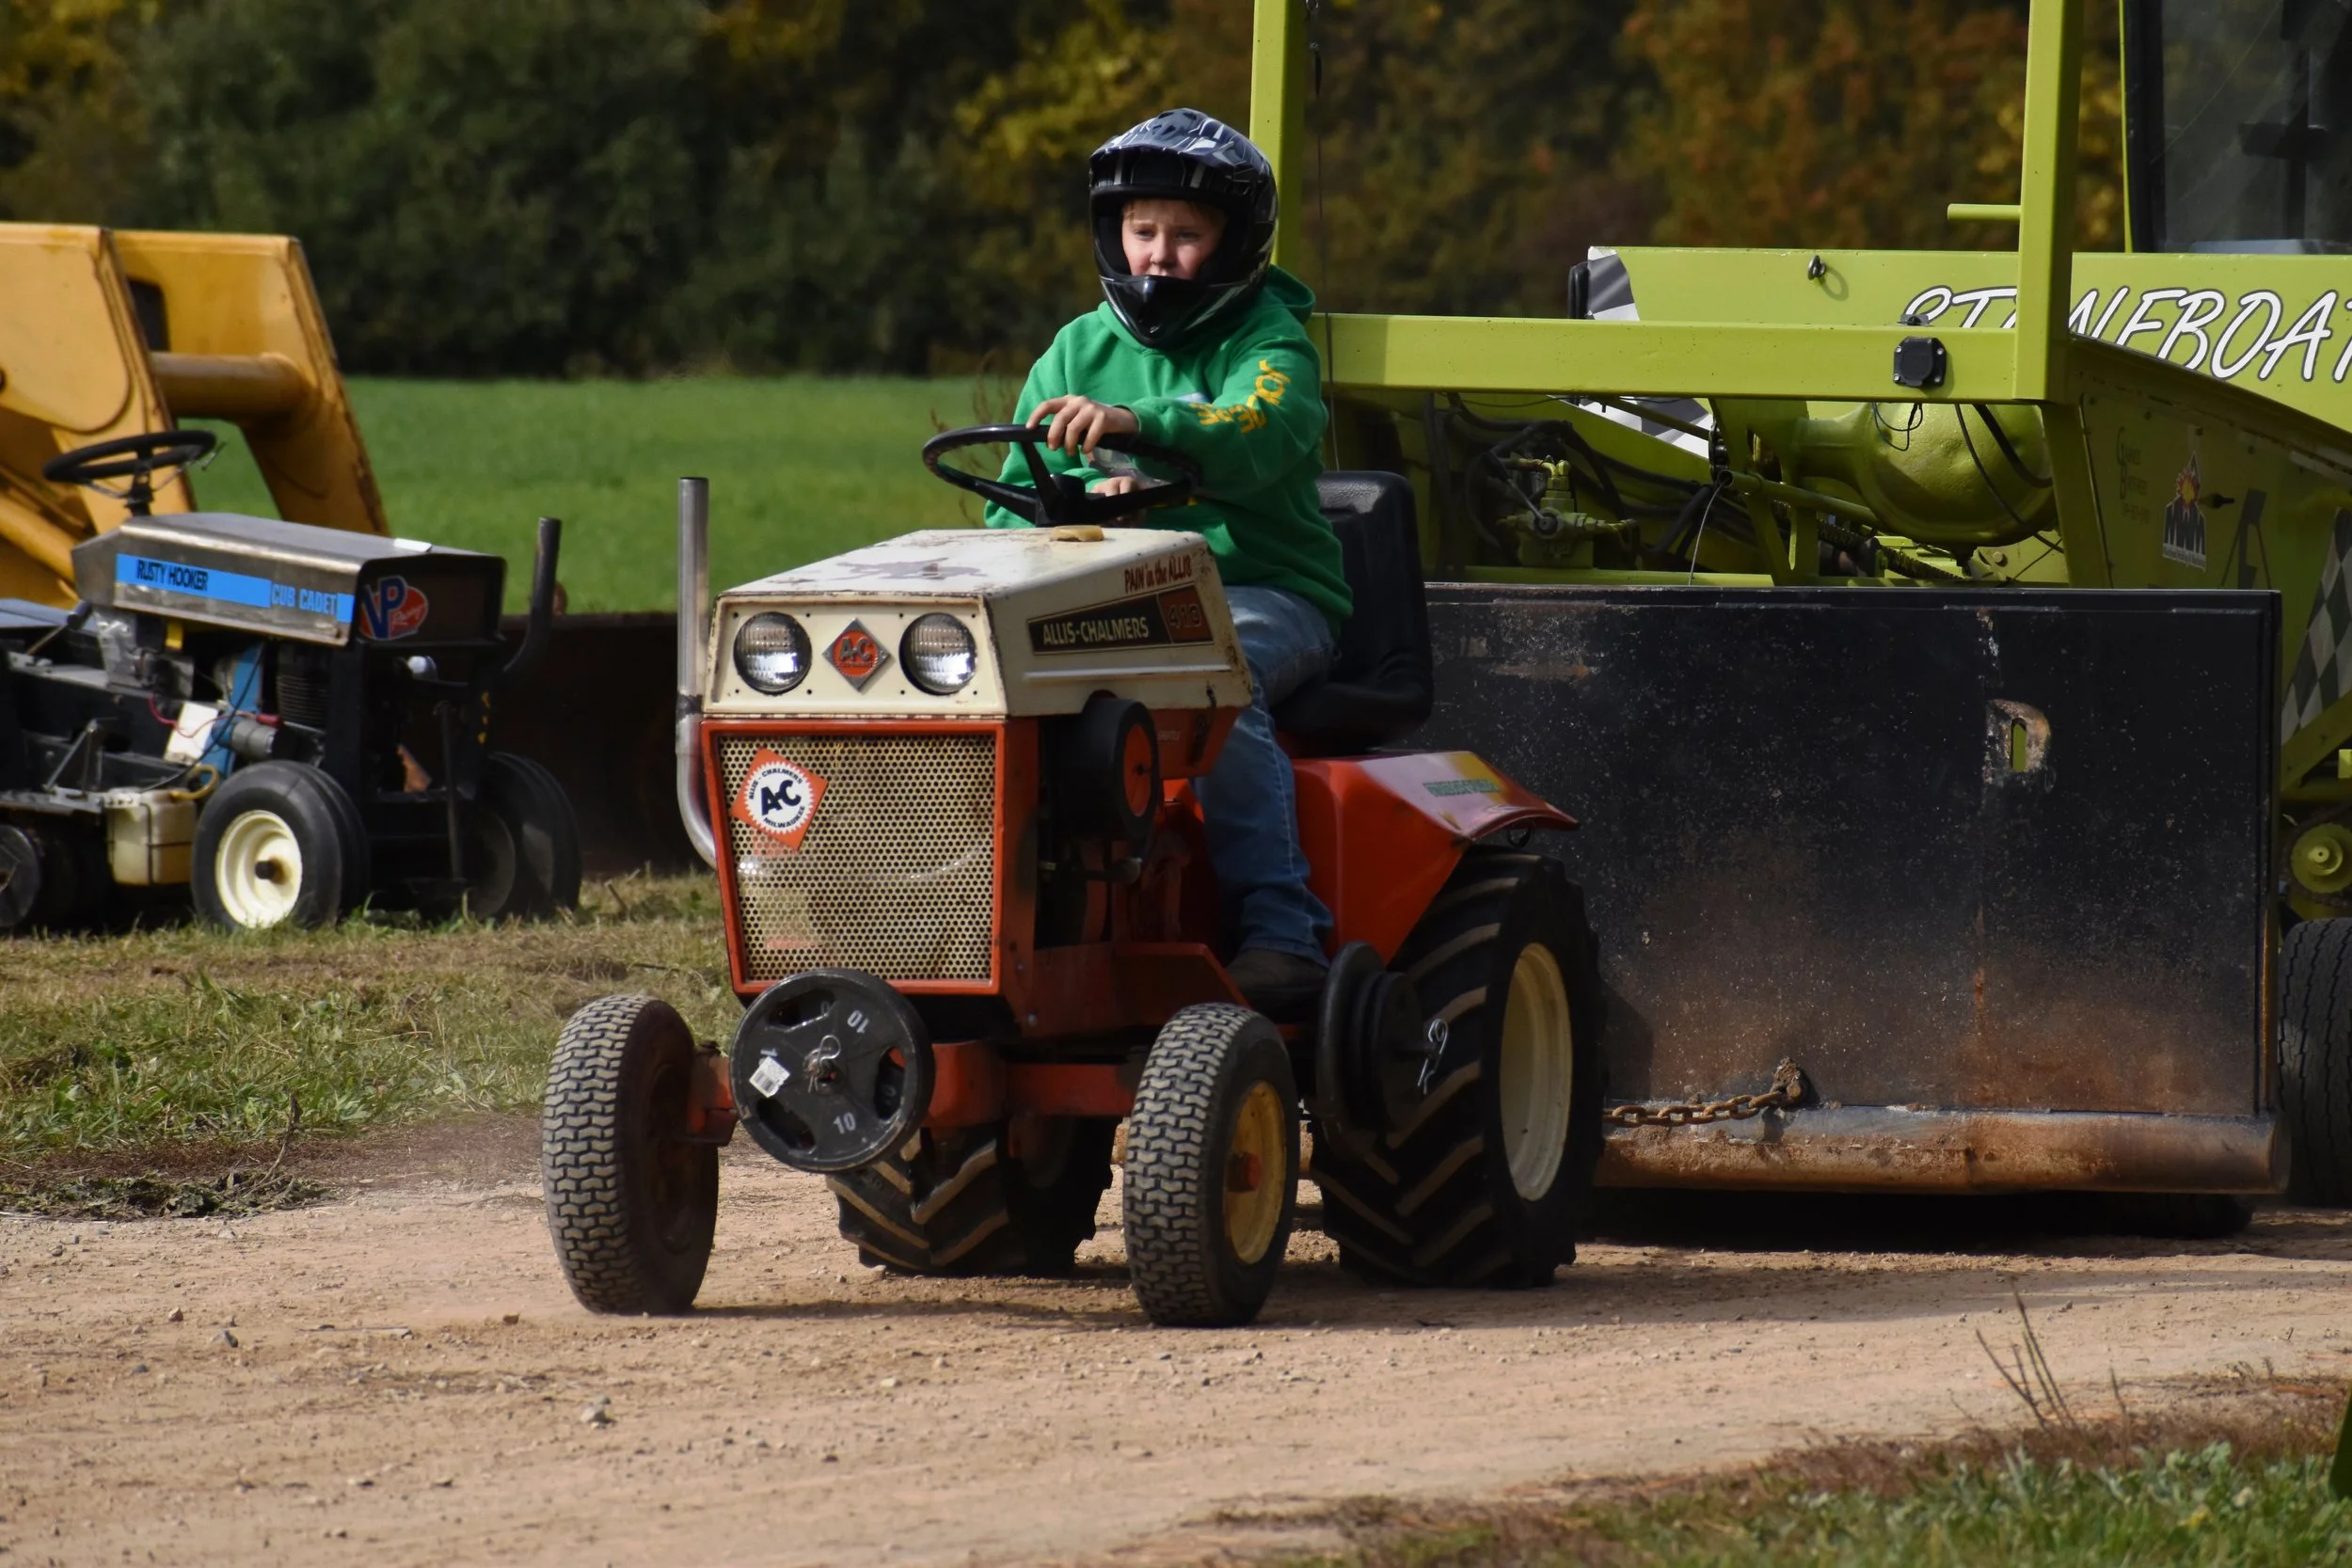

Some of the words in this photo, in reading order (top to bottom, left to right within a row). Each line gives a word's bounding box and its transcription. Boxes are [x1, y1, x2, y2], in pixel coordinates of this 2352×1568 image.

[1902, 285, 2352, 383] TNEBOA
[136, 559, 167, 584] RUSTY
[167, 562, 209, 592] HOOKER
[1124, 567, 1144, 594] PAIN
[272, 583, 295, 608] CUB
[299, 589, 338, 615] CADET
[360, 575, 407, 641] VP
[1042, 616, 1150, 645] ALLIS-CHALMERS
[834, 1112, 856, 1134] 10
